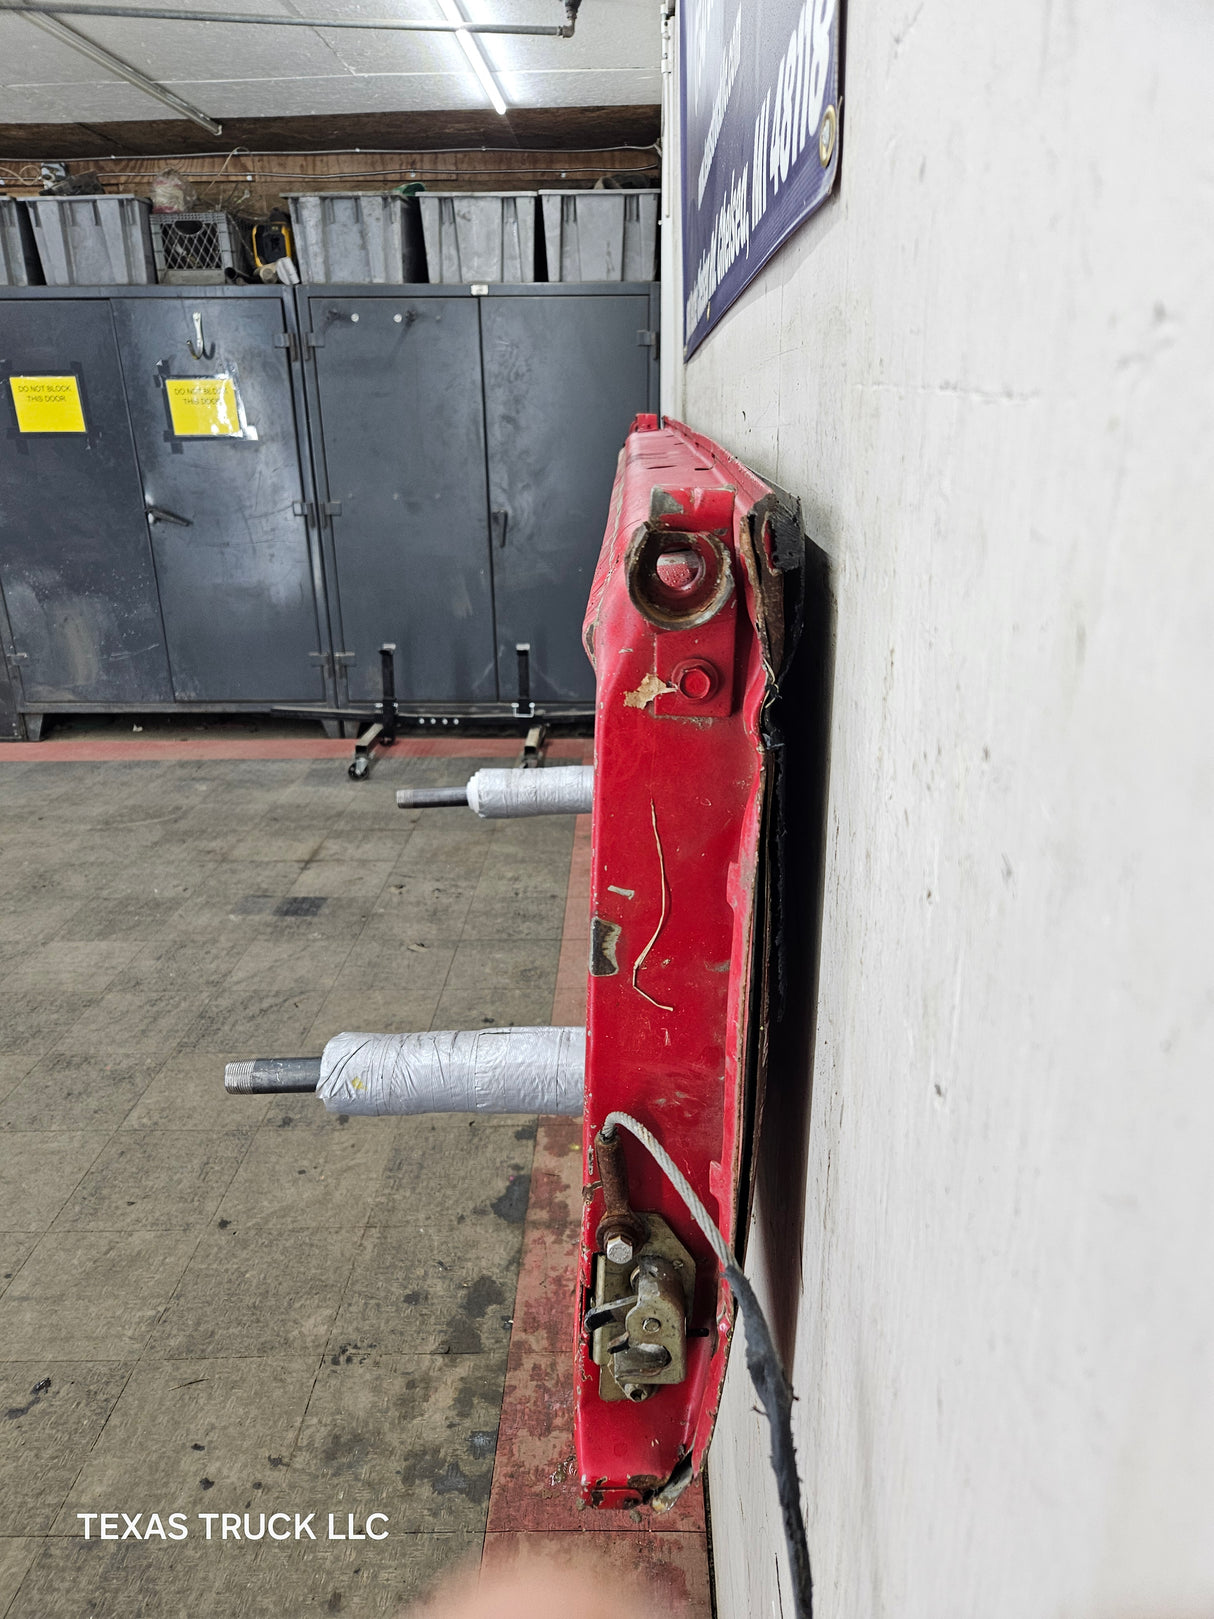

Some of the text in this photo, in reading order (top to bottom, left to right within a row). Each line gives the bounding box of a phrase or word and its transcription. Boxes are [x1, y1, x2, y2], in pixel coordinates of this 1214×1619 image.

[717, 161, 749, 285] Chelsea,
[752, 86, 771, 232] MI
[769, 0, 835, 195] 48118
[17, 385, 72, 393] DO NOT BLOCK
